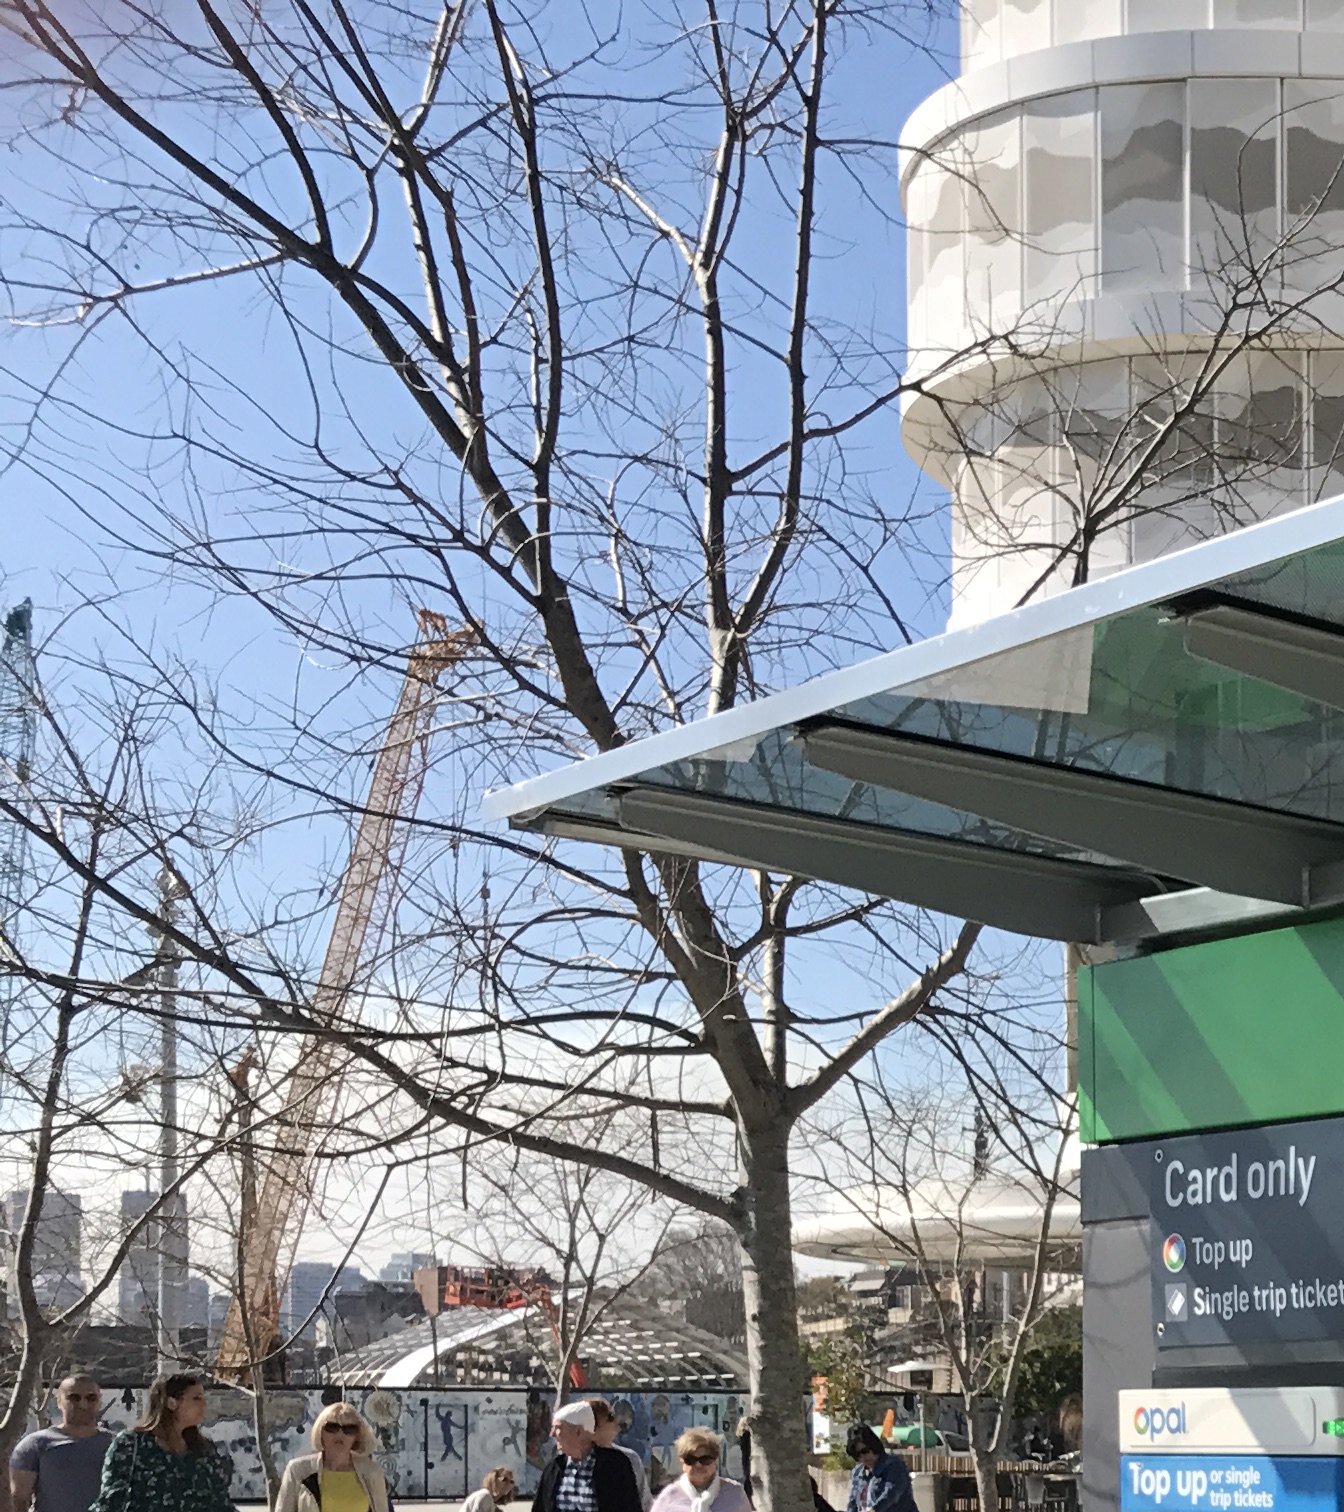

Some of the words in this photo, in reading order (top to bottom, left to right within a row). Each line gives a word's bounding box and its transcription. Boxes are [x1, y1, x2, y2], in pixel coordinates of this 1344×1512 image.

[1164, 1152, 1238, 1208] Card
[1247, 1145, 1317, 1207] only
[1191, 1236, 1225, 1271] Top
[1229, 1238, 1253, 1269] up
[1193, 1285, 1250, 1321] Single
[1253, 1281, 1287, 1318] trip
[1133, 1401, 1188, 1442] opal
[1129, 1462, 1170, 1504] Top
[1176, 1467, 1208, 1505] up
[1210, 1473, 1224, 1485] or
[1225, 1466, 1261, 1489] single
[1210, 1489, 1231, 1510] trip
[1234, 1488, 1274, 1508] tickets
